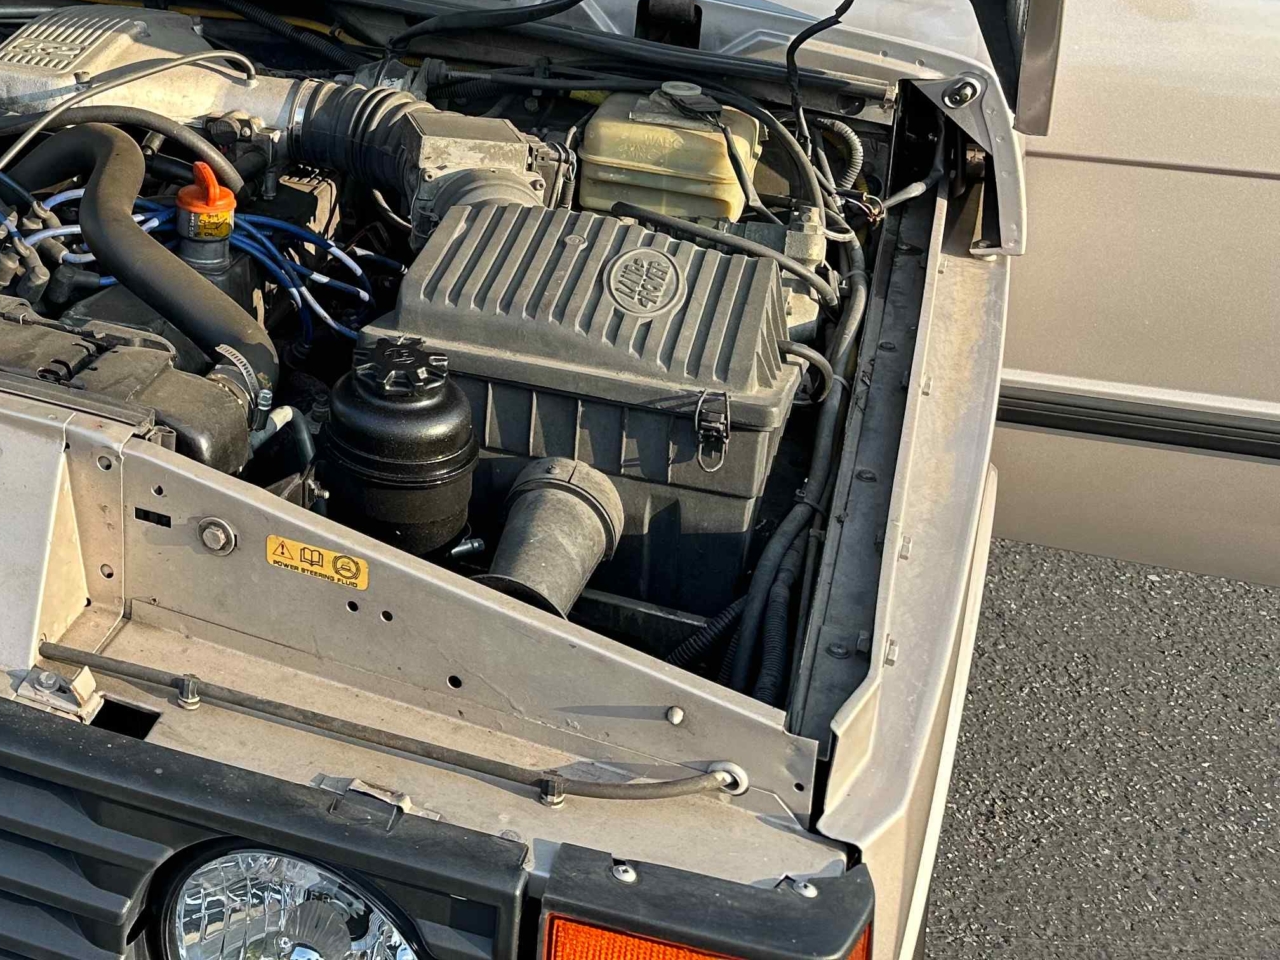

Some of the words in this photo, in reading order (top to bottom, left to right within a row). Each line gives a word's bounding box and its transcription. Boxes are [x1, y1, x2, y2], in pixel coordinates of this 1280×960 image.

[273, 559, 299, 571] POWER
[301, 567, 335, 582] STEERING
[336, 577, 358, 588] FLUID
